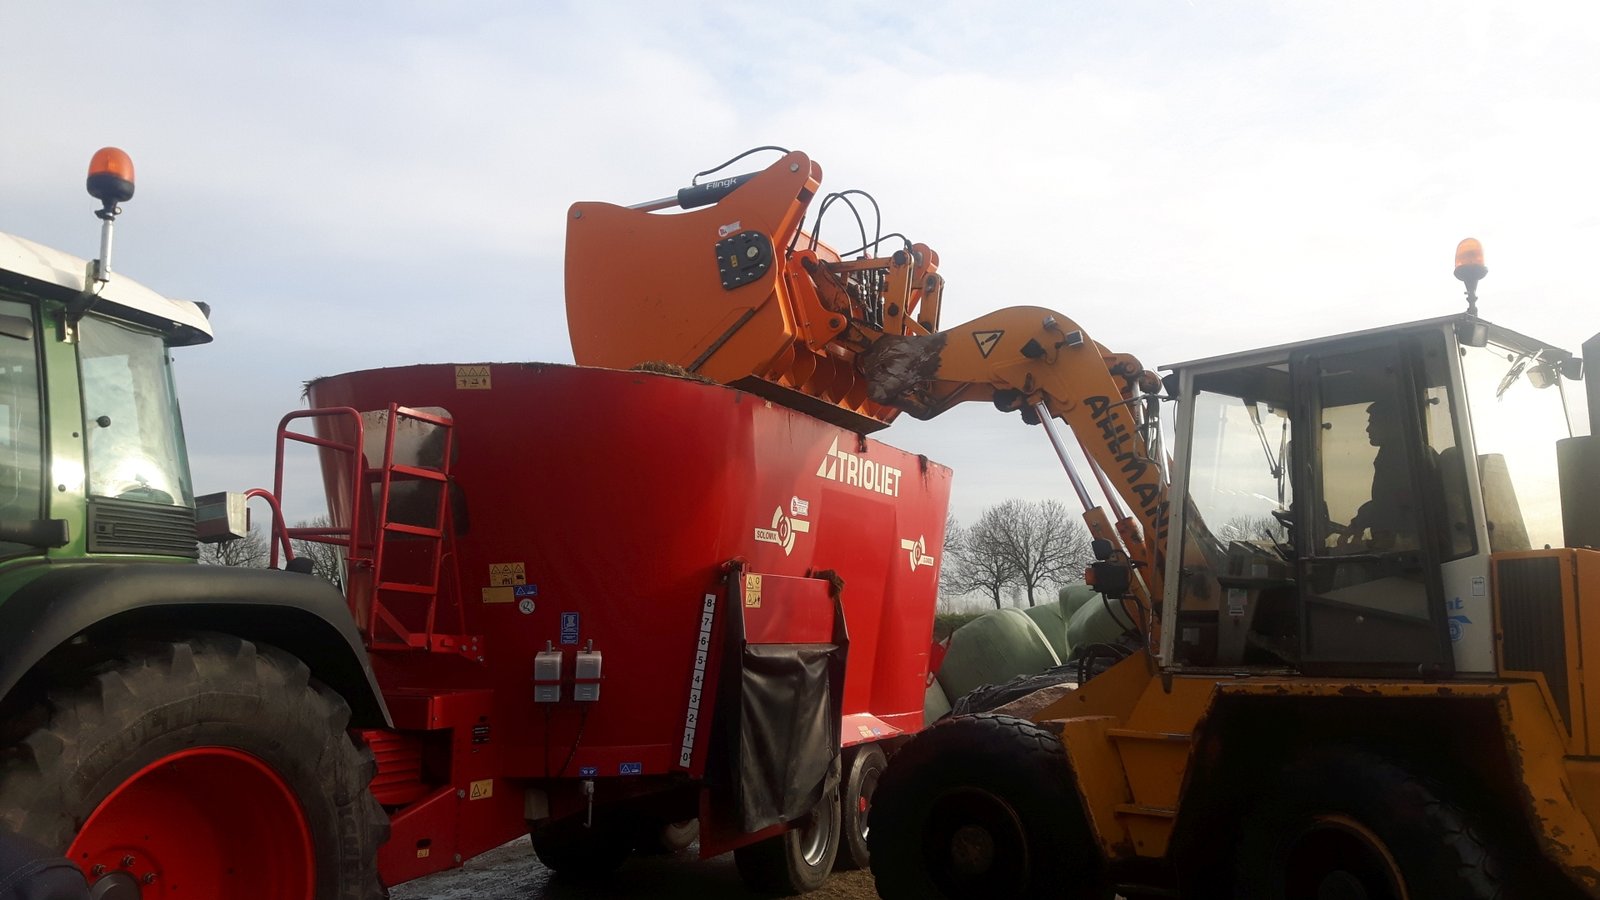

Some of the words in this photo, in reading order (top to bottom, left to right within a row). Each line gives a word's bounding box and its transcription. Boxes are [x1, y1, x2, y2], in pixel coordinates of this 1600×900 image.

[706, 178, 737, 190] Flingk
[838, 450, 902, 497] TRIOLIET
[1084, 395, 1170, 551] AHLMAN
[706, 598, 713, 608] 8
[703, 618, 710, 627] 7
[700, 636, 707, 645] 6
[697, 656, 703, 664] 5
[694, 675, 701, 684] 4
[691, 694, 697, 703] 3
[688, 714, 695, 722] 2
[686, 733, 691, 741] 1
[682, 752, 688, 761] 0
